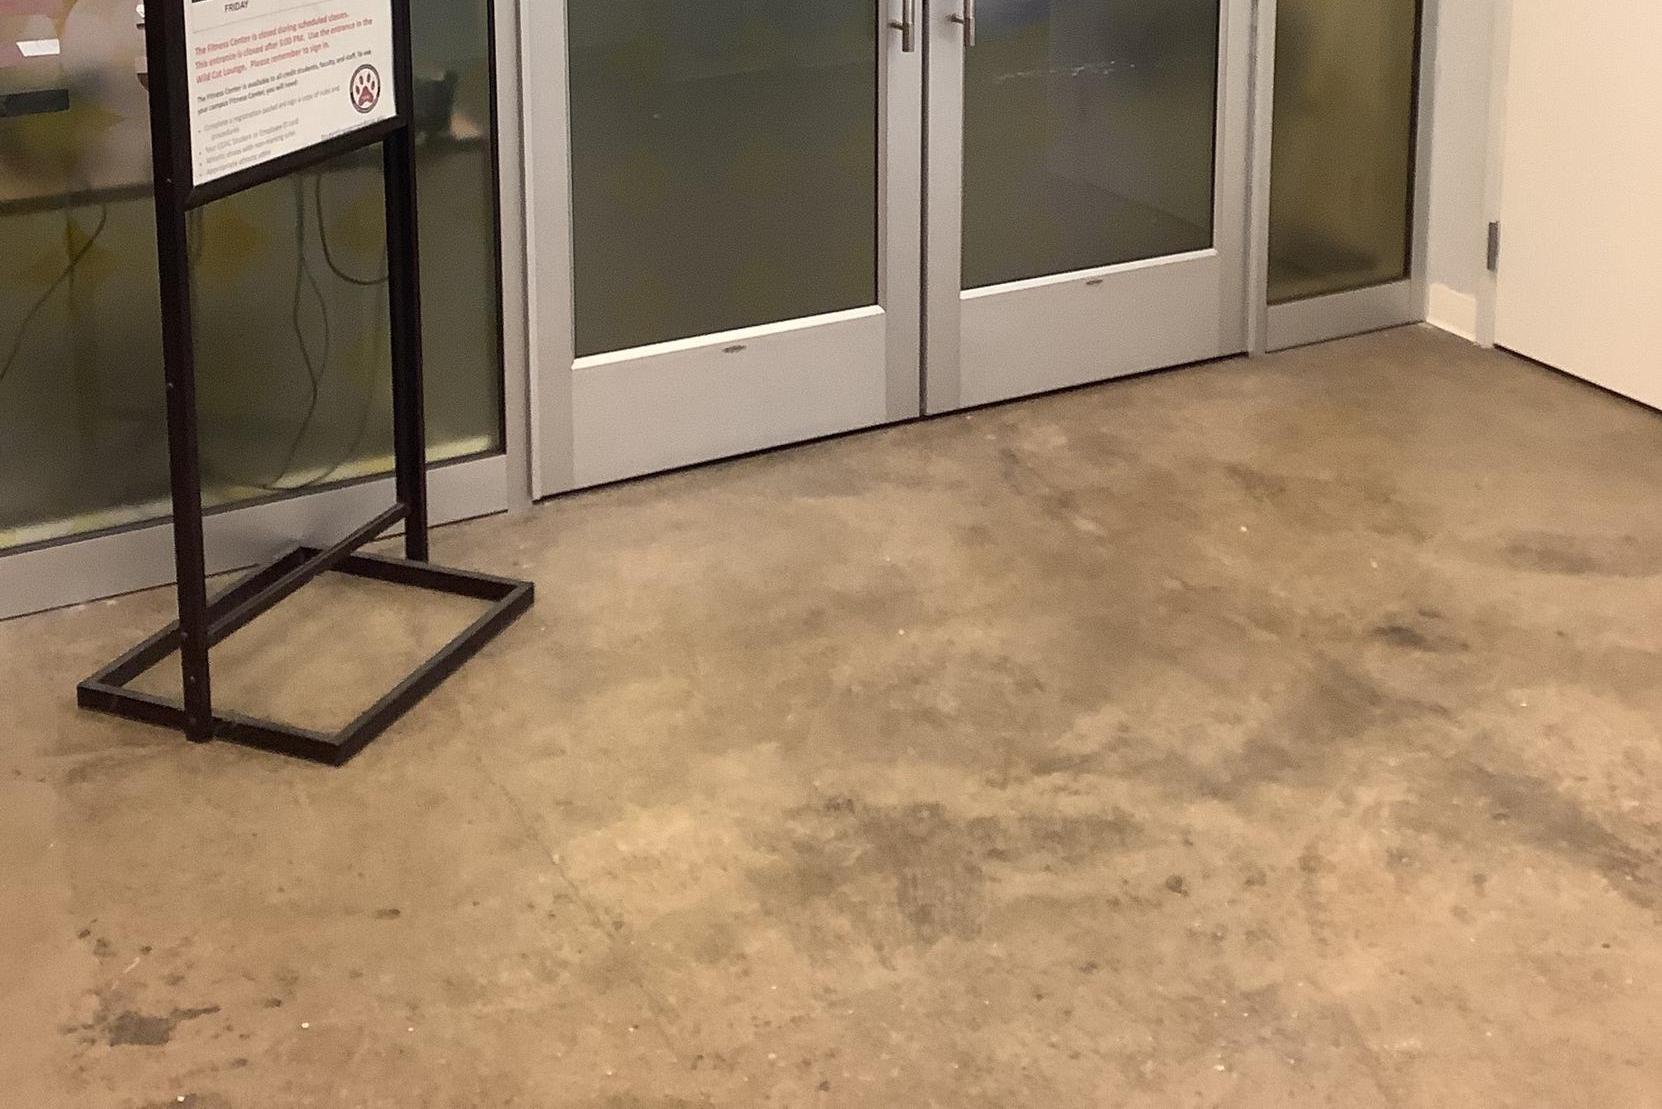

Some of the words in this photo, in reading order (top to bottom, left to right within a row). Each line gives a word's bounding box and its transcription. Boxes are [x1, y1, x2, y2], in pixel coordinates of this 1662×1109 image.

[224, 0, 249, 13] FRIDAY
[195, 47, 206, 56] The
[207, 42, 229, 52] Fitness
[230, 36, 250, 46] Center
[252, 33, 258, 41] is
[258, 28, 277, 40] closed
[278, 24, 297, 35] during
[298, 16, 328, 29] scheduled
[328, 12, 350, 22] classes.
[195, 60, 208, 69] This
[209, 53, 236, 66] entrance
[243, 44, 264, 57] closed
[264, 42, 278, 52] after
[308, 31, 320, 40] Use
[320, 28, 330, 36] the
[330, 22, 355, 34] entrance
[362, 18, 373, 26] the
[196, 72, 210, 84] Wild
[212, 70, 222, 79] Cat
[223, 64, 247, 77] Lounge.
[250, 58, 270, 68] Please
[271, 48, 301, 63] remember
[310, 44, 322, 53] sign
[206, 91, 224, 100] Fitness
[225, 86, 242, 95] Center
[248, 78, 270, 88] available
[336, 56, 345, 64] and
[197, 107, 208, 116] your
[208, 100, 228, 111] campus
[229, 95, 248, 104] Fitness
[266, 88, 275, 96] you
[276, 82, 284, 91] will
